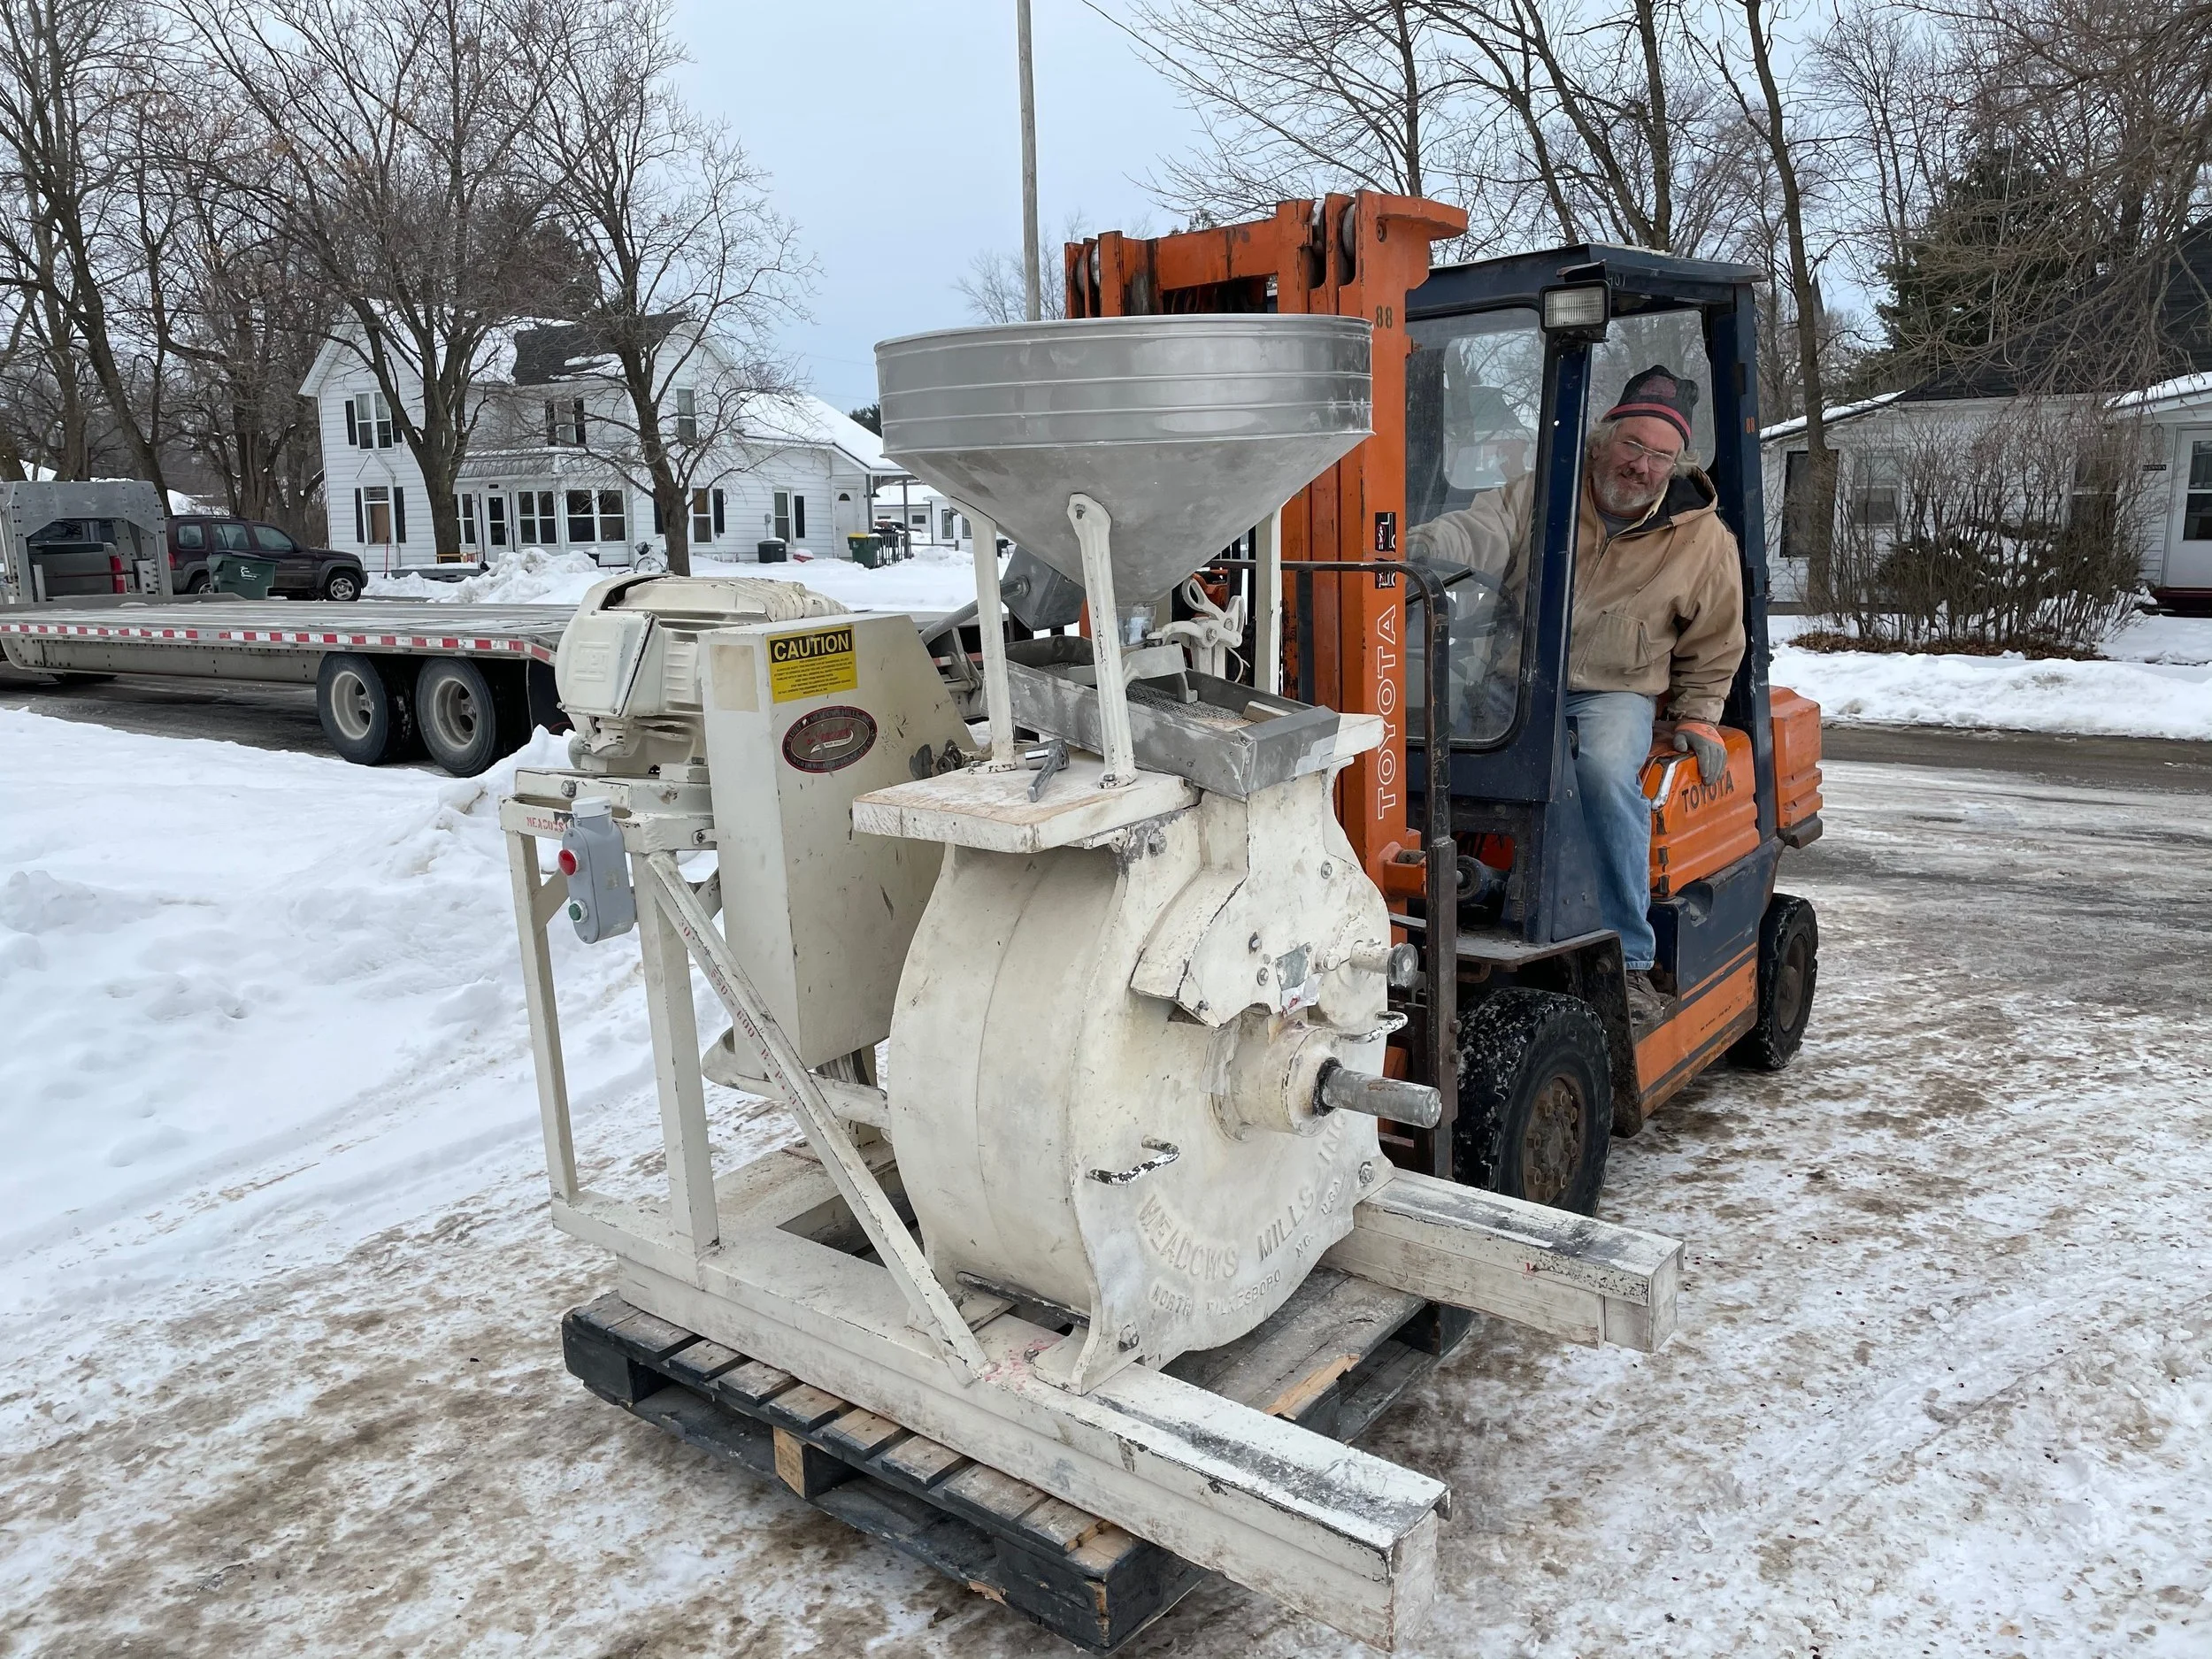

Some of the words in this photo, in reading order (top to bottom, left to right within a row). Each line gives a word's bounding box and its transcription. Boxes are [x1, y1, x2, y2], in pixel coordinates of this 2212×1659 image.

[1376, 304, 1393, 329] 88
[773, 633, 849, 661] CAUTION
[1377, 603, 1396, 820] TOYOTA
[1682, 770, 1734, 812] TOYOTA
[1138, 1194, 1239, 1280] MEADOWS
[1257, 1183, 1314, 1263] MILLS
